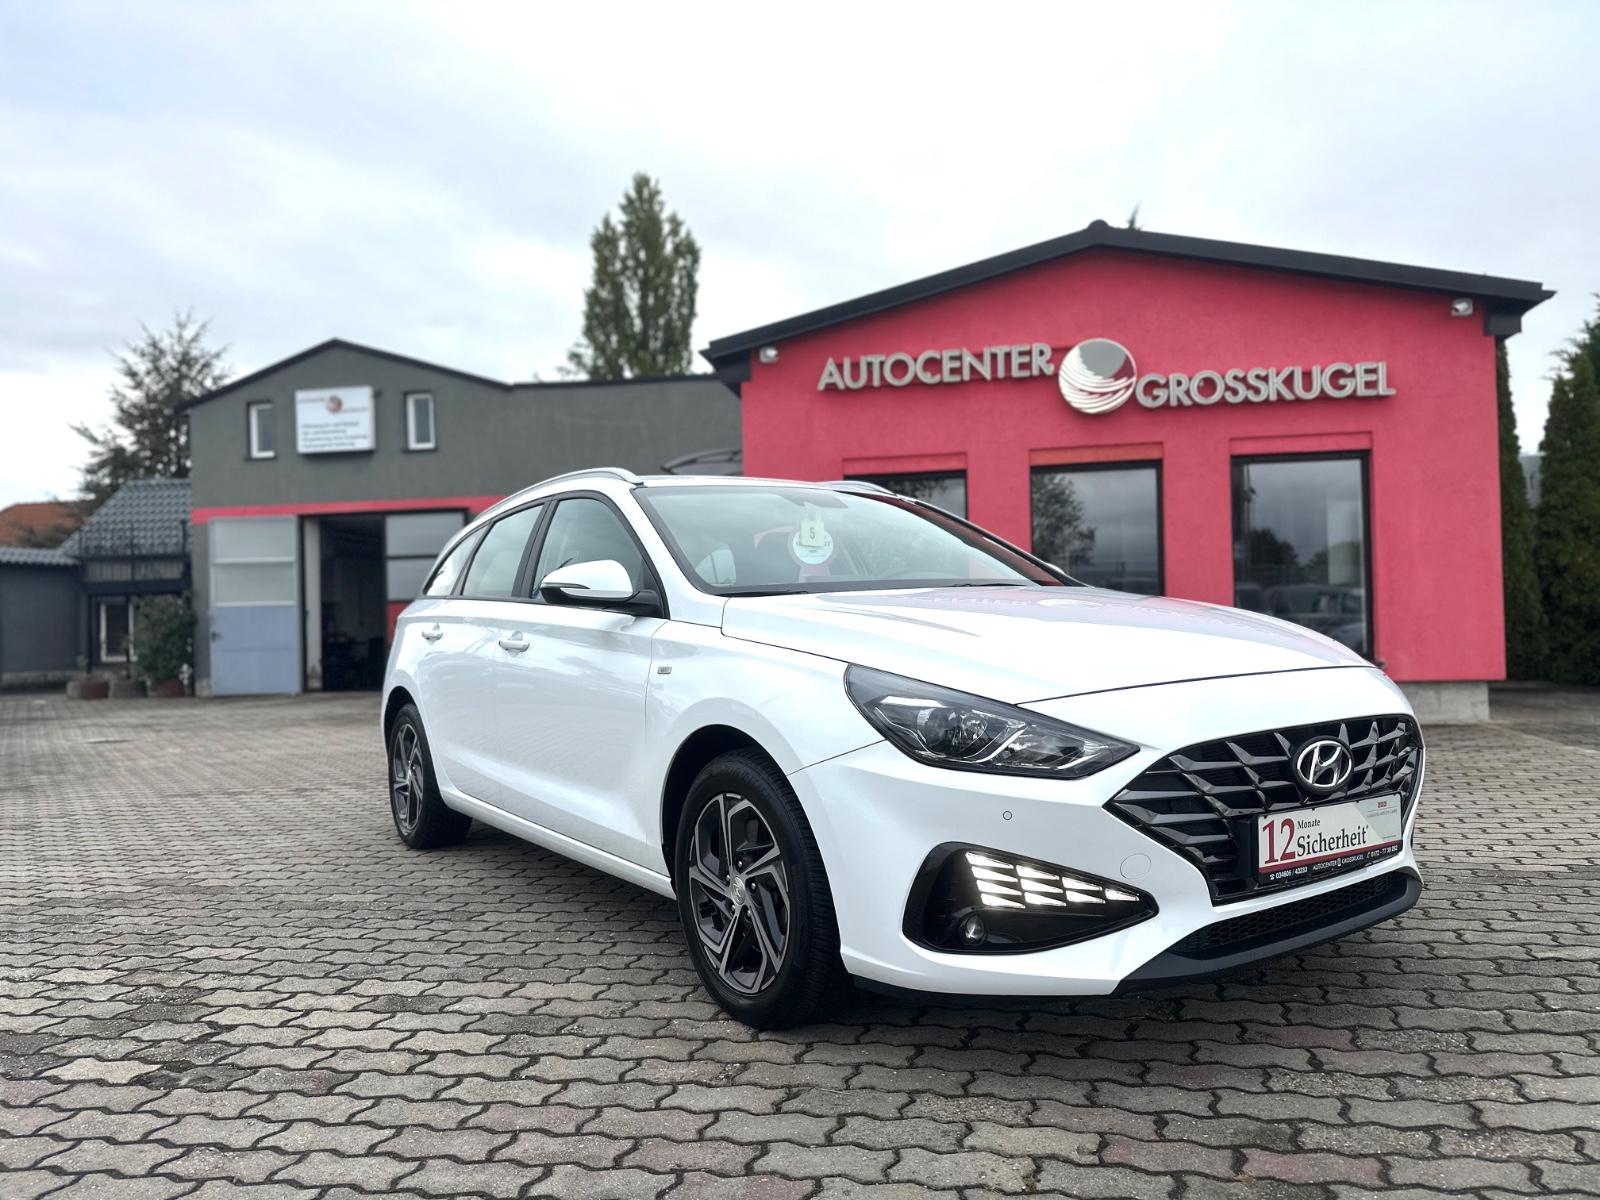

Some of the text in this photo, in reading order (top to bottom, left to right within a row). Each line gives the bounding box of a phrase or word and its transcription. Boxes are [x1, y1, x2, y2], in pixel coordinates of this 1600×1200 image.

[817, 343, 1397, 409] AUTOCENTER GROSSKUGEL
[1262, 817, 1296, 864] 12
[1297, 819, 1321, 830] Monate
